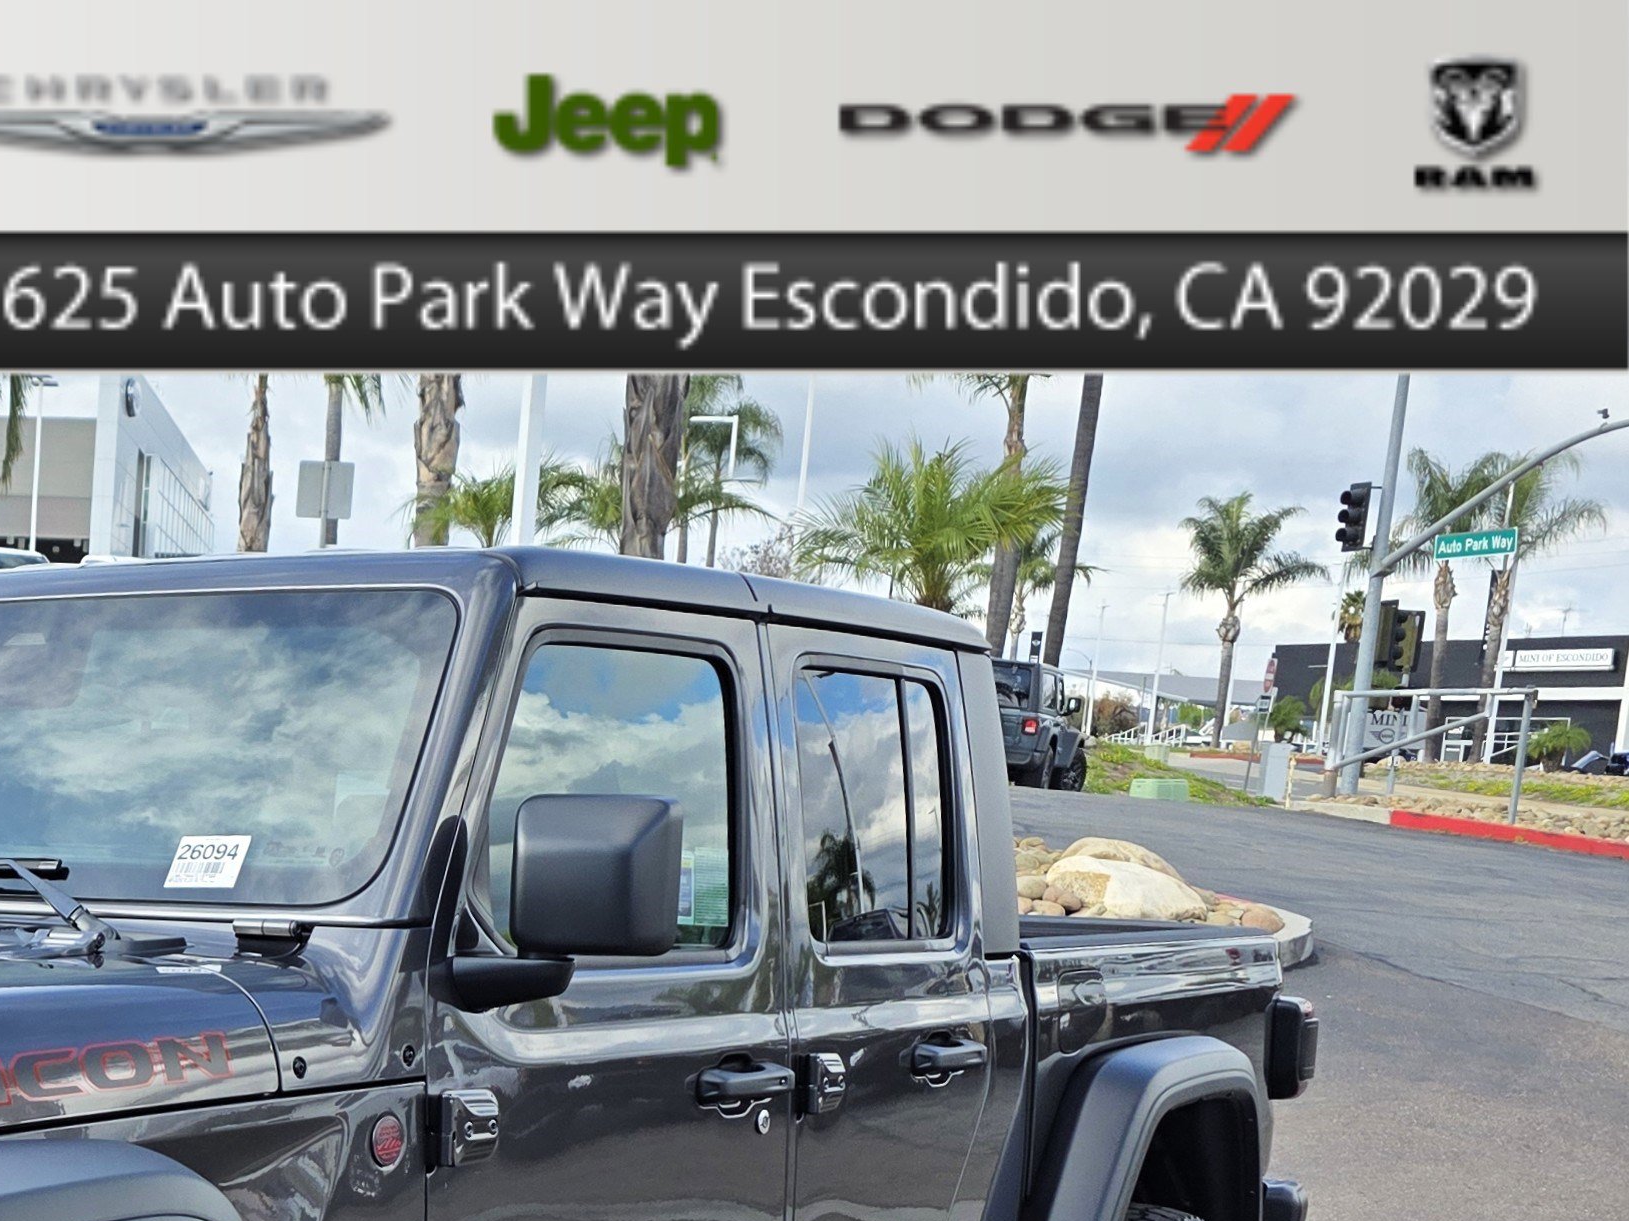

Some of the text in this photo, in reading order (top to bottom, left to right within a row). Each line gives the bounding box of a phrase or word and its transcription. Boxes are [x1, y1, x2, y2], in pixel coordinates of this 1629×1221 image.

[1438, 535, 1513, 554] Auto Park Way
[1519, 651, 1609, 663] MINI OF ESCONDIDO
[177, 843, 240, 861] 26094
